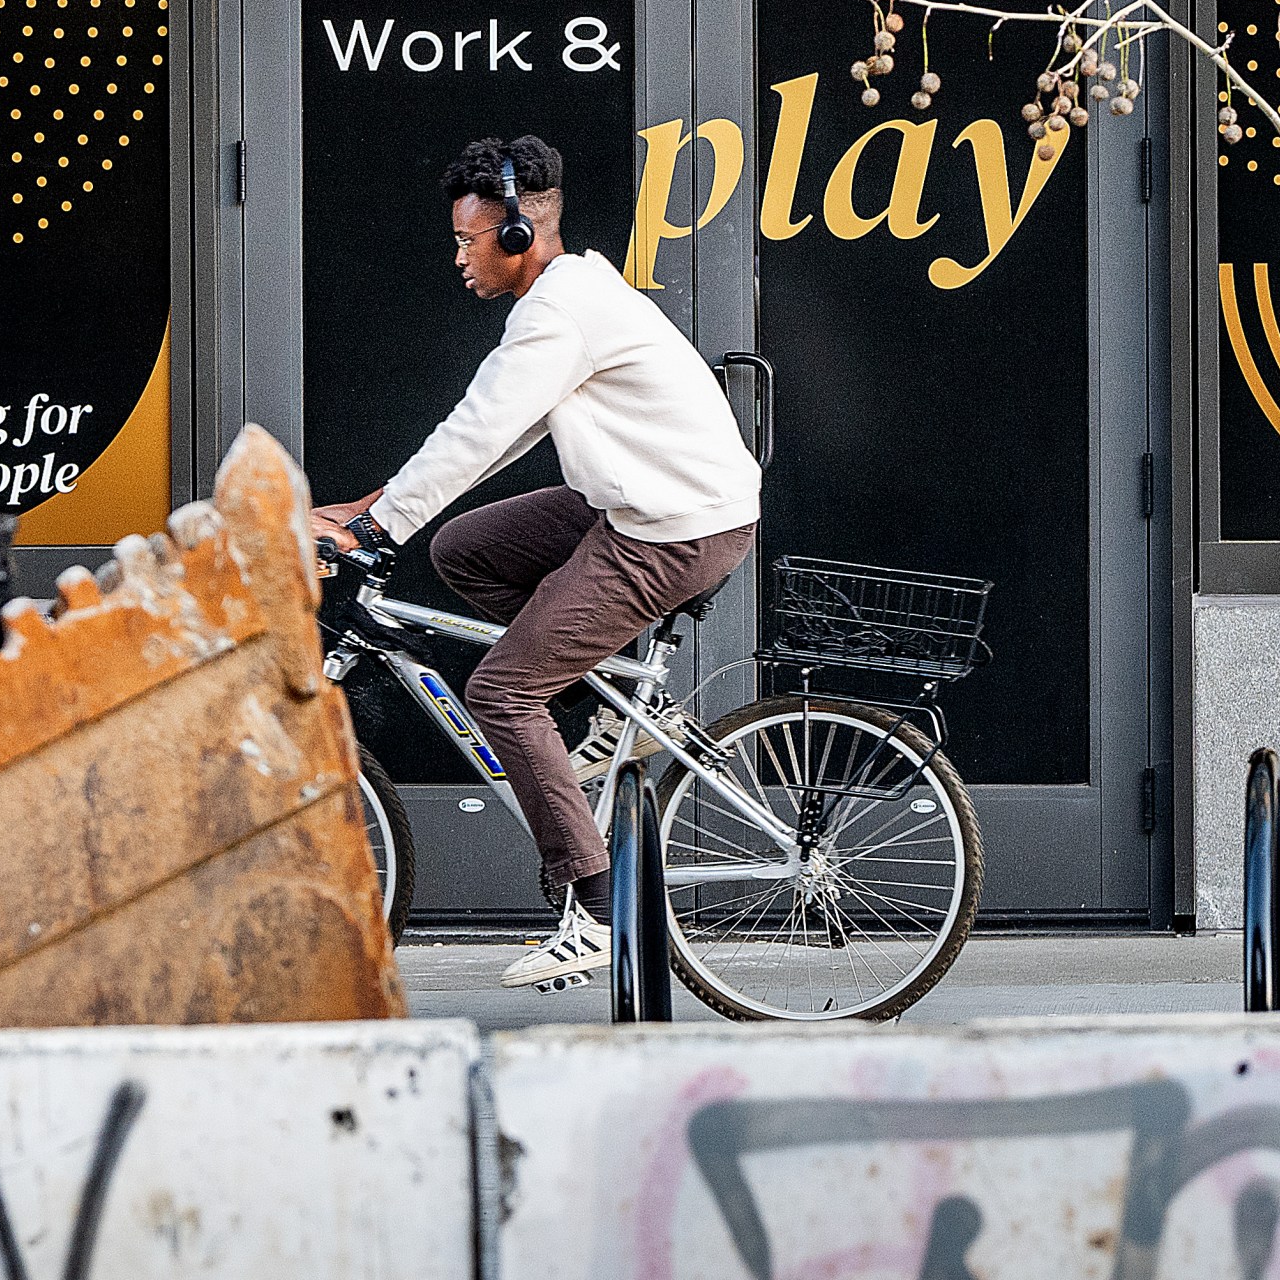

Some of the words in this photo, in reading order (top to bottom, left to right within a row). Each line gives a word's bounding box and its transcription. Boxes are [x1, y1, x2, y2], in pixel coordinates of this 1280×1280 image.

[322, 18, 534, 72] Work
[561, 16, 622, 71] &
[623, 72, 1071, 291] play
[13, 393, 93, 448] for
